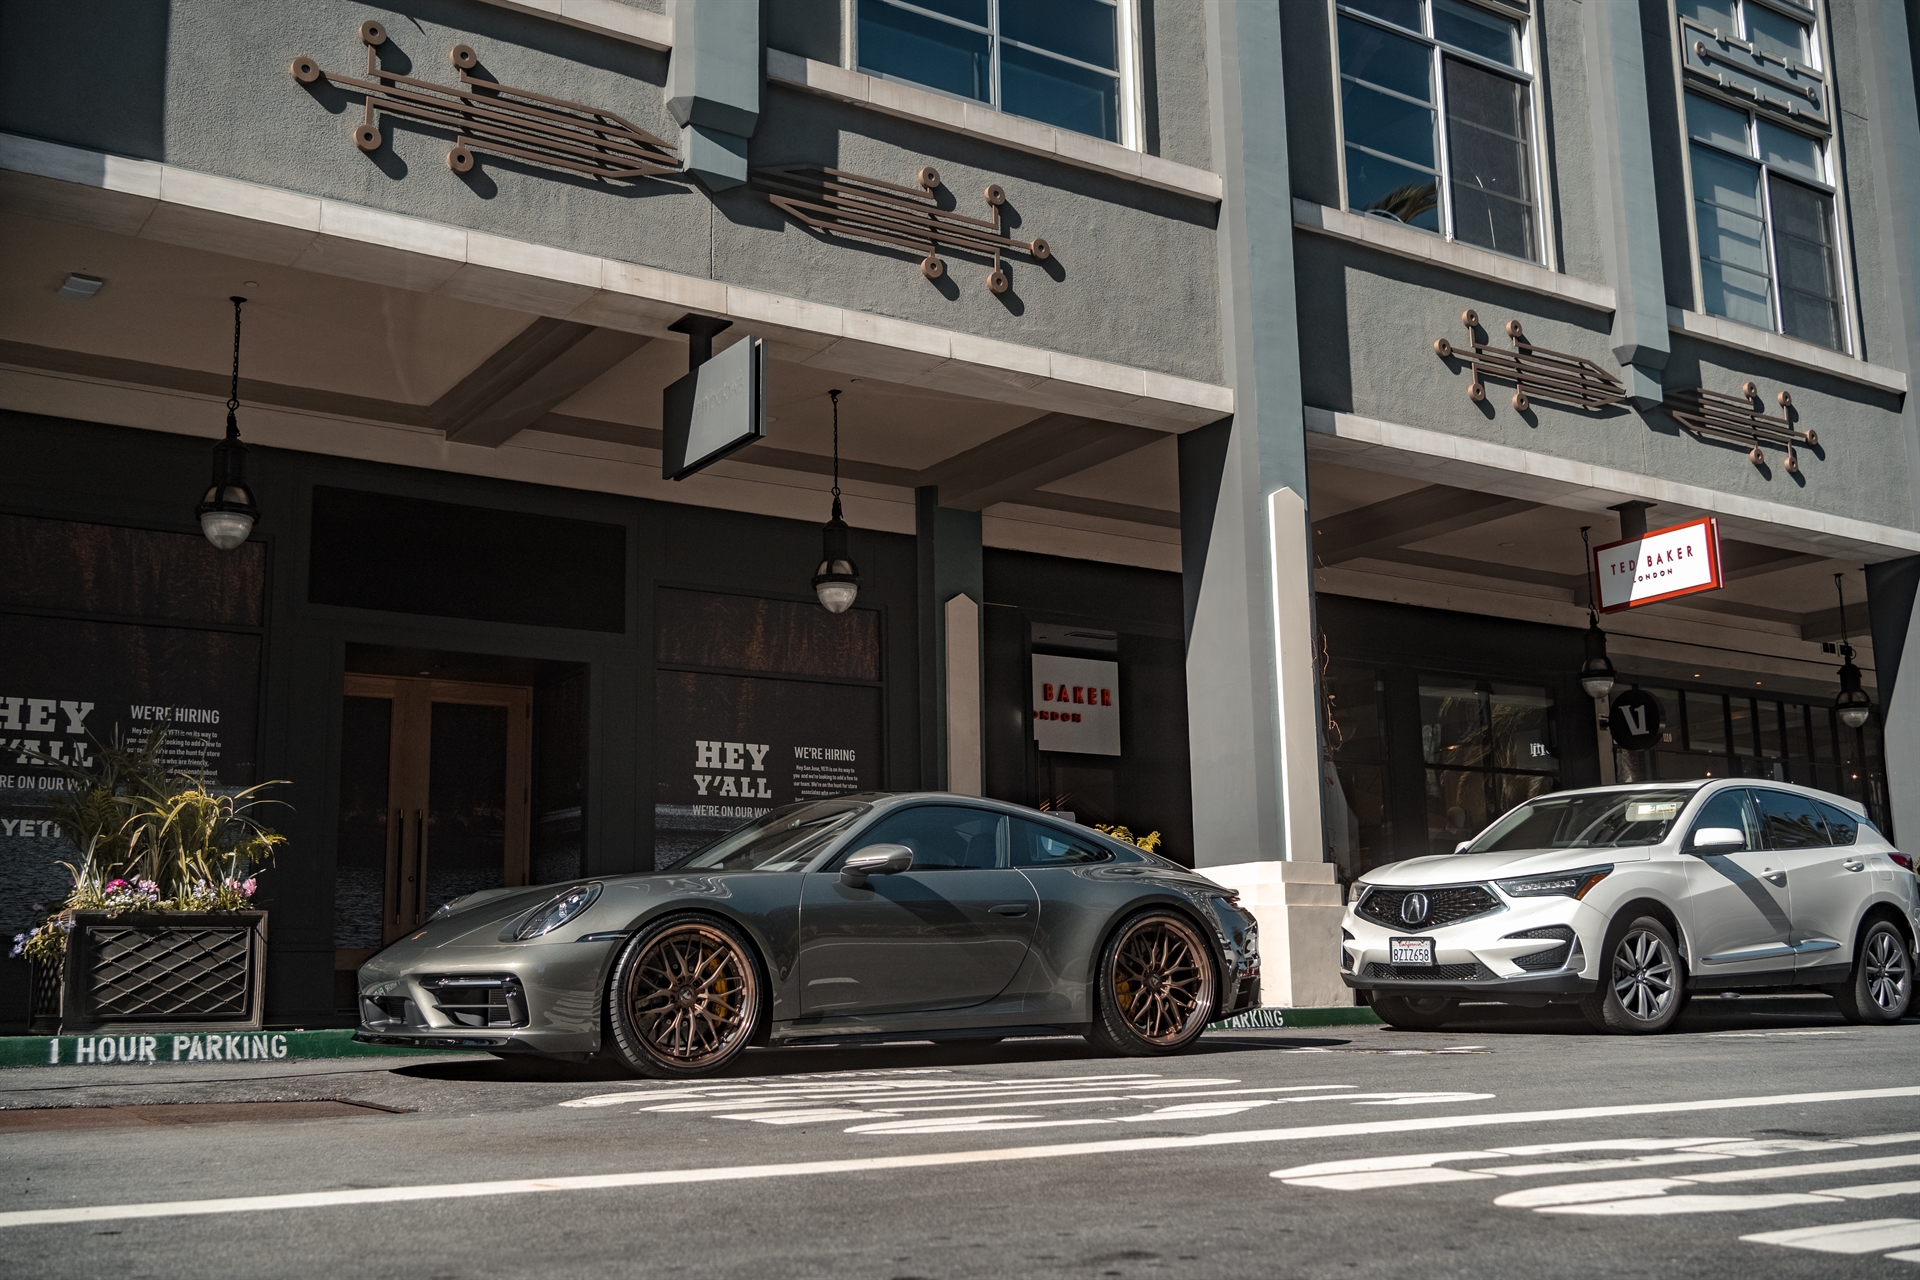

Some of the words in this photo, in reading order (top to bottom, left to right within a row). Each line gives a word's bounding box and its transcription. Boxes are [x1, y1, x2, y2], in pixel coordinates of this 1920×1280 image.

[1610, 560, 1636, 576] TED
[1646, 545, 1694, 567] BAKER
[1632, 568, 1673, 583] LONDON
[1044, 683, 1112, 706] BAKER
[0, 696, 95, 734] HEY
[130, 705, 172, 721] WE'RE
[175, 708, 220, 724] HIRING
[1034, 710, 1082, 723] ONDON
[0, 738, 94, 768] 'ALL
[695, 740, 770, 771] HEY
[794, 747, 823, 760] WE'RE
[825, 748, 856, 761] HIRING
[18, 775, 36, 788] ON
[38, 776, 64, 790] OUR
[693, 774, 772, 798] Y'ALL
[692, 804, 720, 817] WE'RE
[721, 806, 734, 817] ON
[735, 806, 753, 818] OUR
[1394, 949, 1429, 962] 8ZIZ658
[50, 1038, 60, 1064] 1
[76, 1036, 157, 1064] HOUR
[172, 1034, 288, 1062] PARKING
